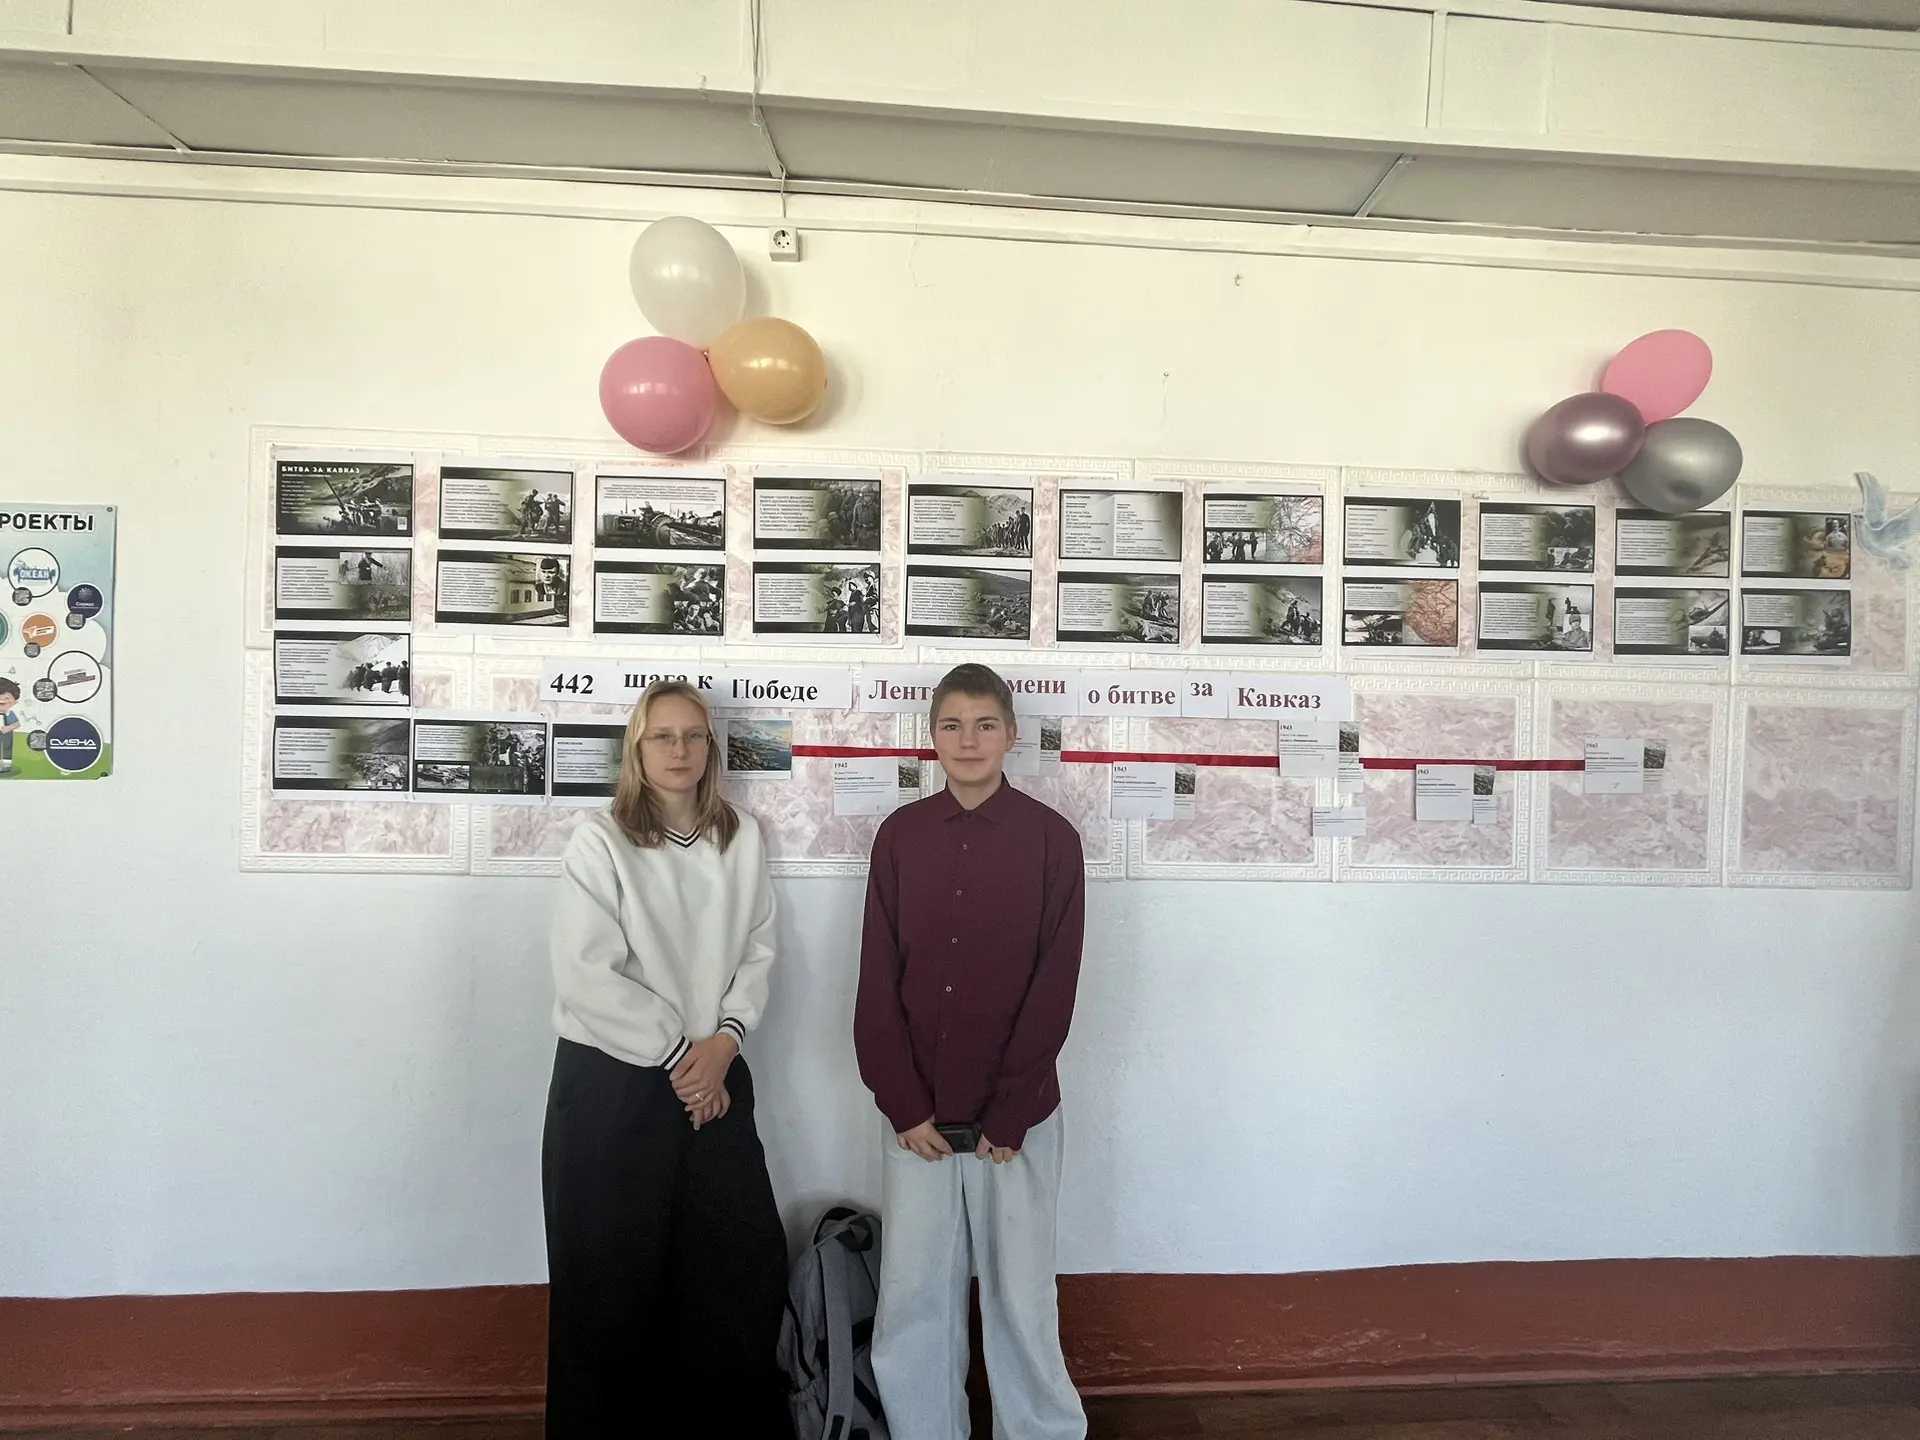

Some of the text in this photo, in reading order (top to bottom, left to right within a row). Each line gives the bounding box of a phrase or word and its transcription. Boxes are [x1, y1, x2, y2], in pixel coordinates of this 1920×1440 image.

[281, 465, 310, 473] БИТВА
[0, 512, 94, 531] РОЕКТЫ
[550, 673, 594, 695] 442
[697, 675, 713, 690] к
[732, 678, 818, 702] Победе
[868, 679, 1321, 709] Лент мени о битве за Кавказ
